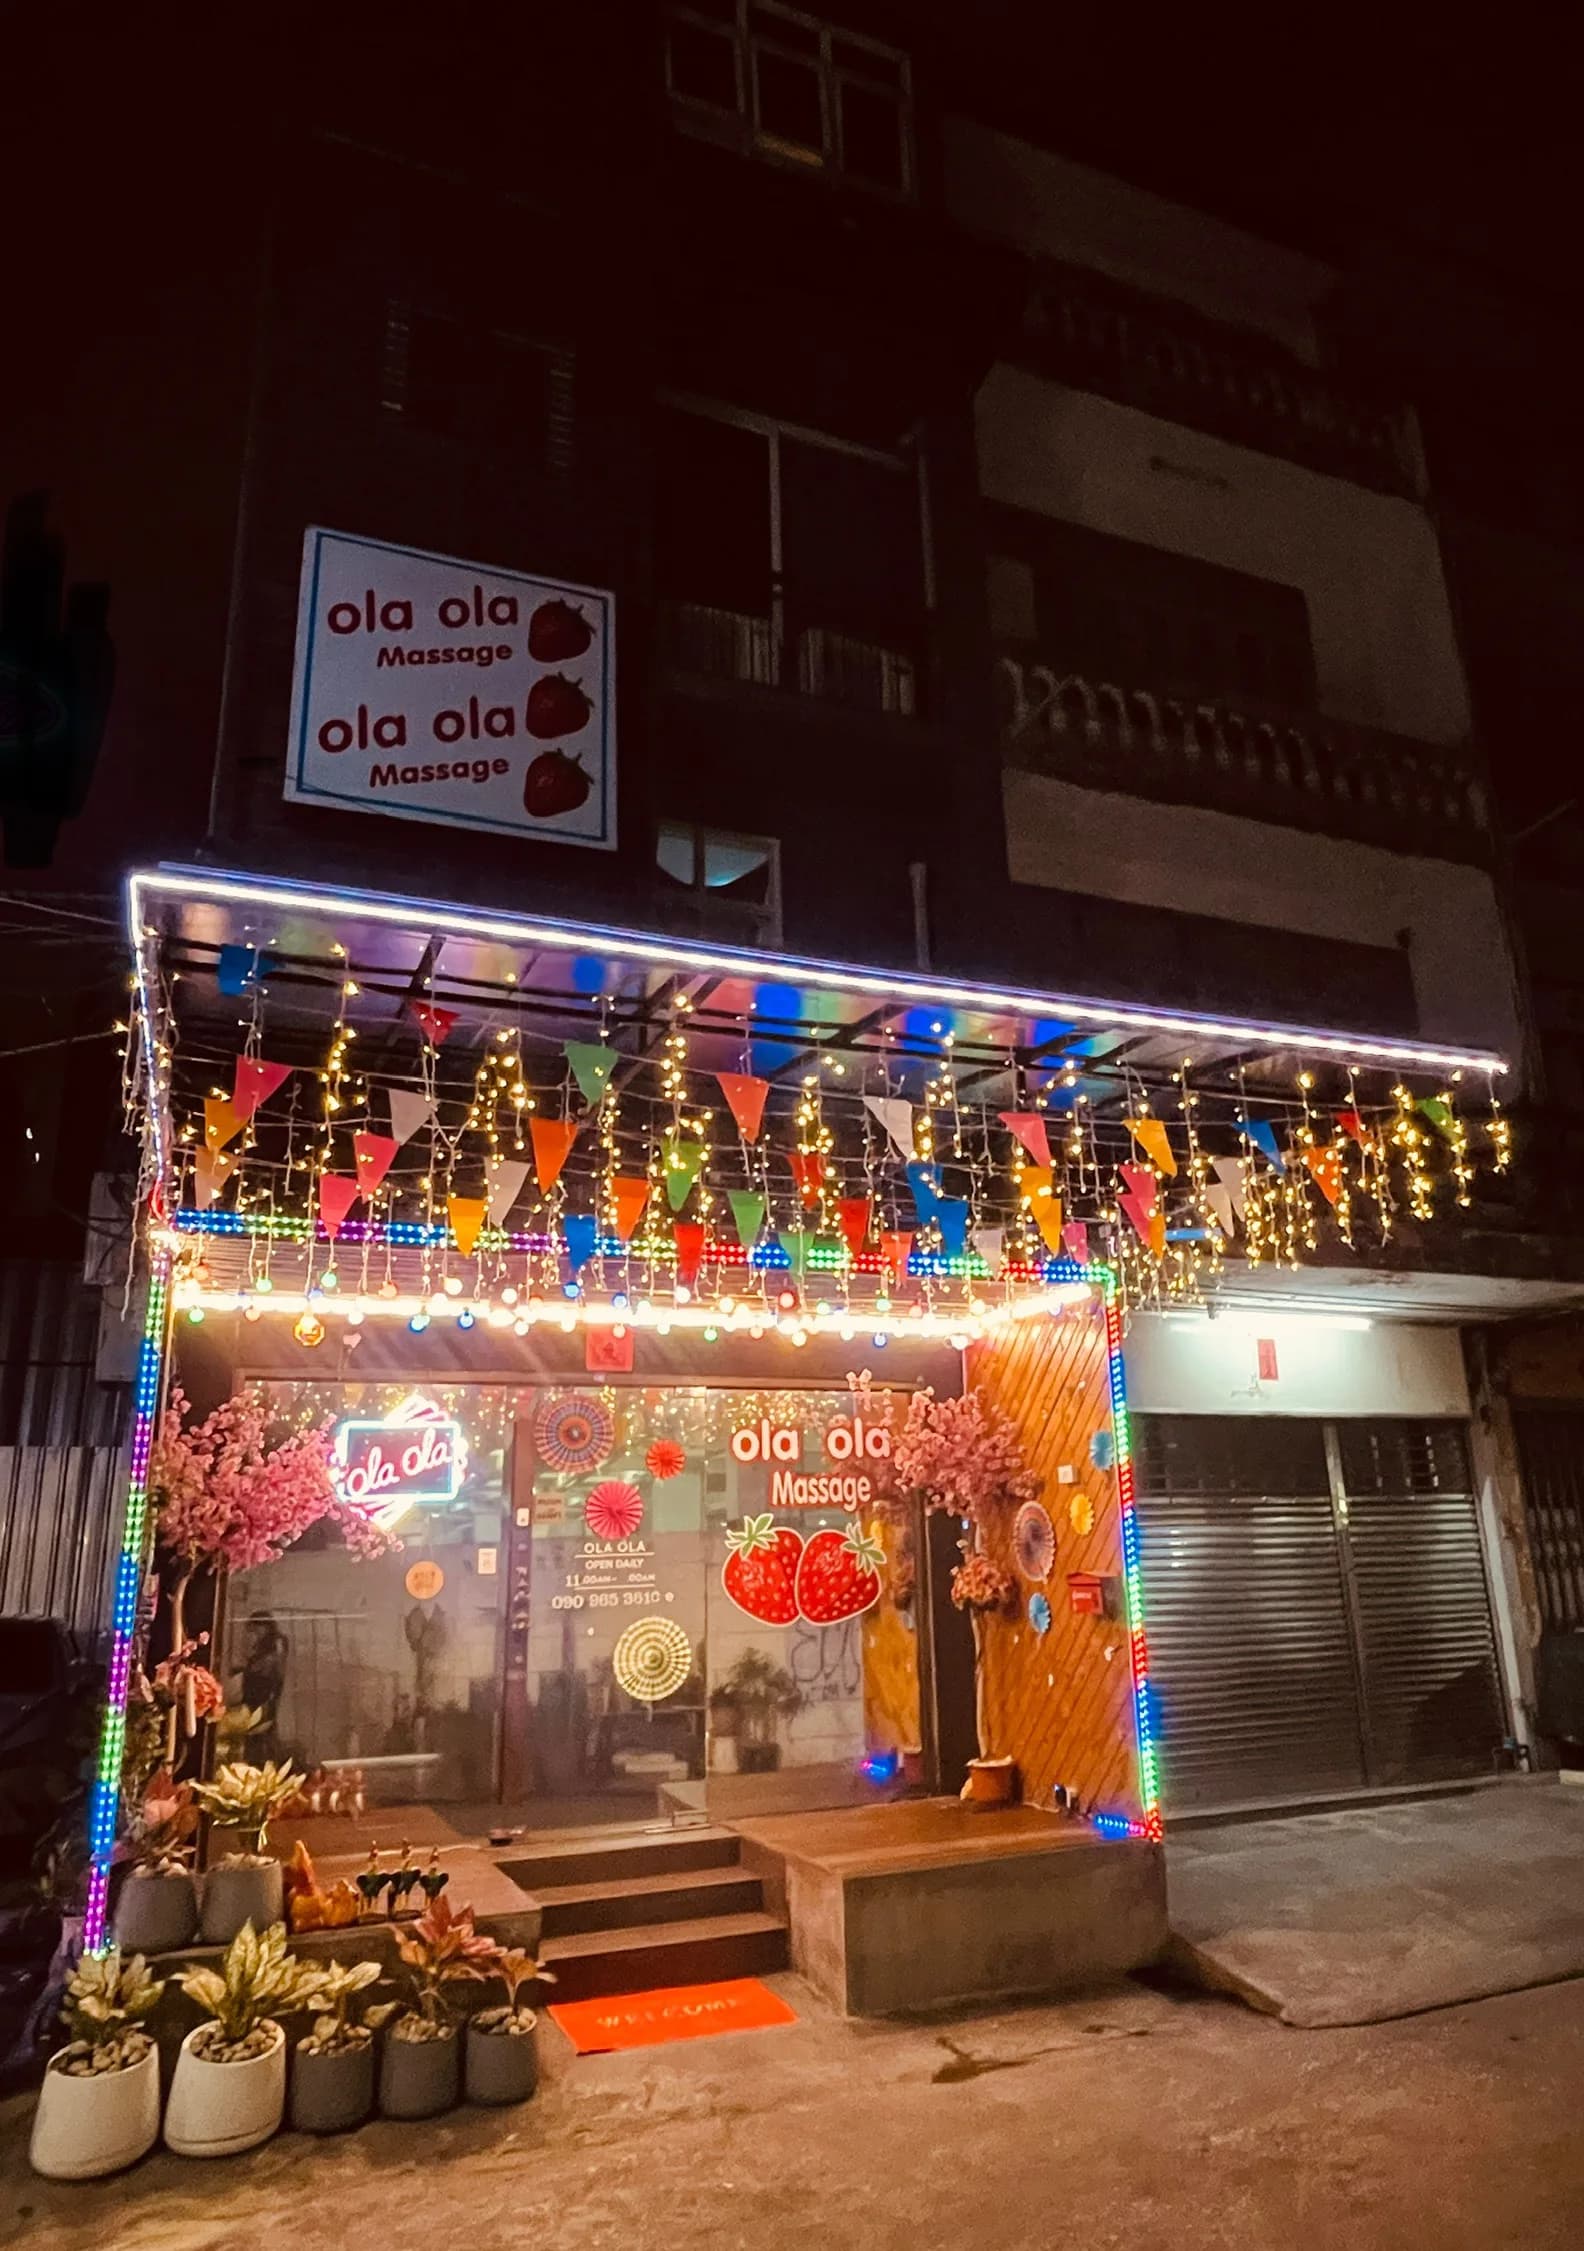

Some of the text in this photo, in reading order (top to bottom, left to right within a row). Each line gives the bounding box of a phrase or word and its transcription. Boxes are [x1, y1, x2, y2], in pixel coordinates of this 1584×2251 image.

[327, 584, 519, 635] ola ola
[377, 644, 513, 668] Massage
[318, 695, 516, 753] ola ola
[369, 757, 510, 788] Massage
[732, 1416, 891, 1462] ola ola
[772, 1471, 872, 1512] Massage
[584, 1540, 646, 1554] OLA OLA
[585, 1558, 645, 1570] OPEN DAILY
[551, 1595, 585, 1609] 090
